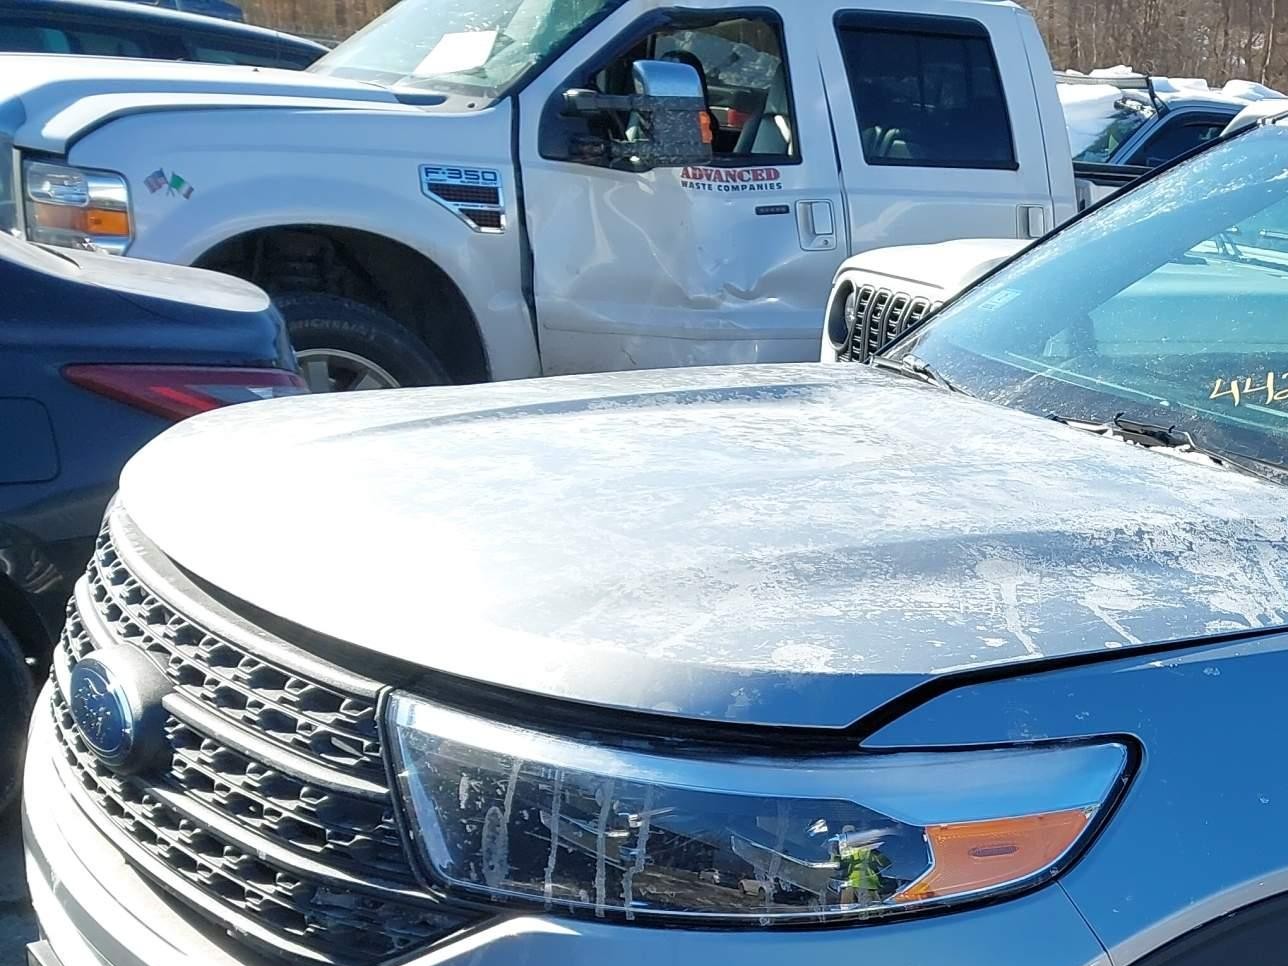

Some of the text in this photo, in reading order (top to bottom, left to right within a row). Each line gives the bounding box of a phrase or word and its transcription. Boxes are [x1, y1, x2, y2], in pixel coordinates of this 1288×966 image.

[680, 165, 780, 183] ADVANCED
[681, 181, 783, 192] WASTE COMPANIES
